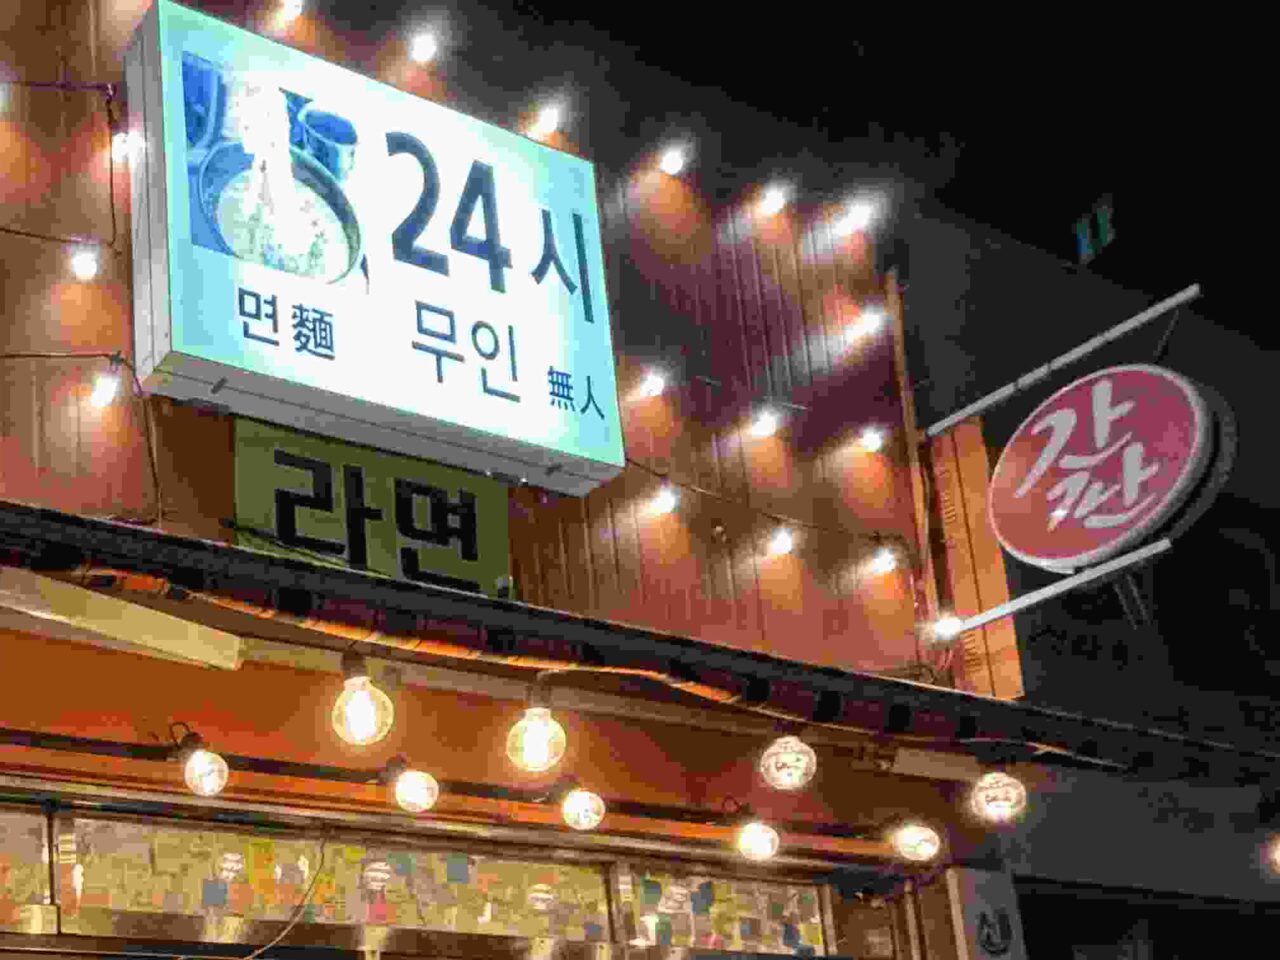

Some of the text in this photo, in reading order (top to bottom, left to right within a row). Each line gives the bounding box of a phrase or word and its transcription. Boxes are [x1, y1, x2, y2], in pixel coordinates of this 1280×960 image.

[384, 130, 596, 324] 24시
[411, 299, 521, 404] 무인
[546, 364, 607, 420] 無人
[272, 447, 480, 594] 라면
